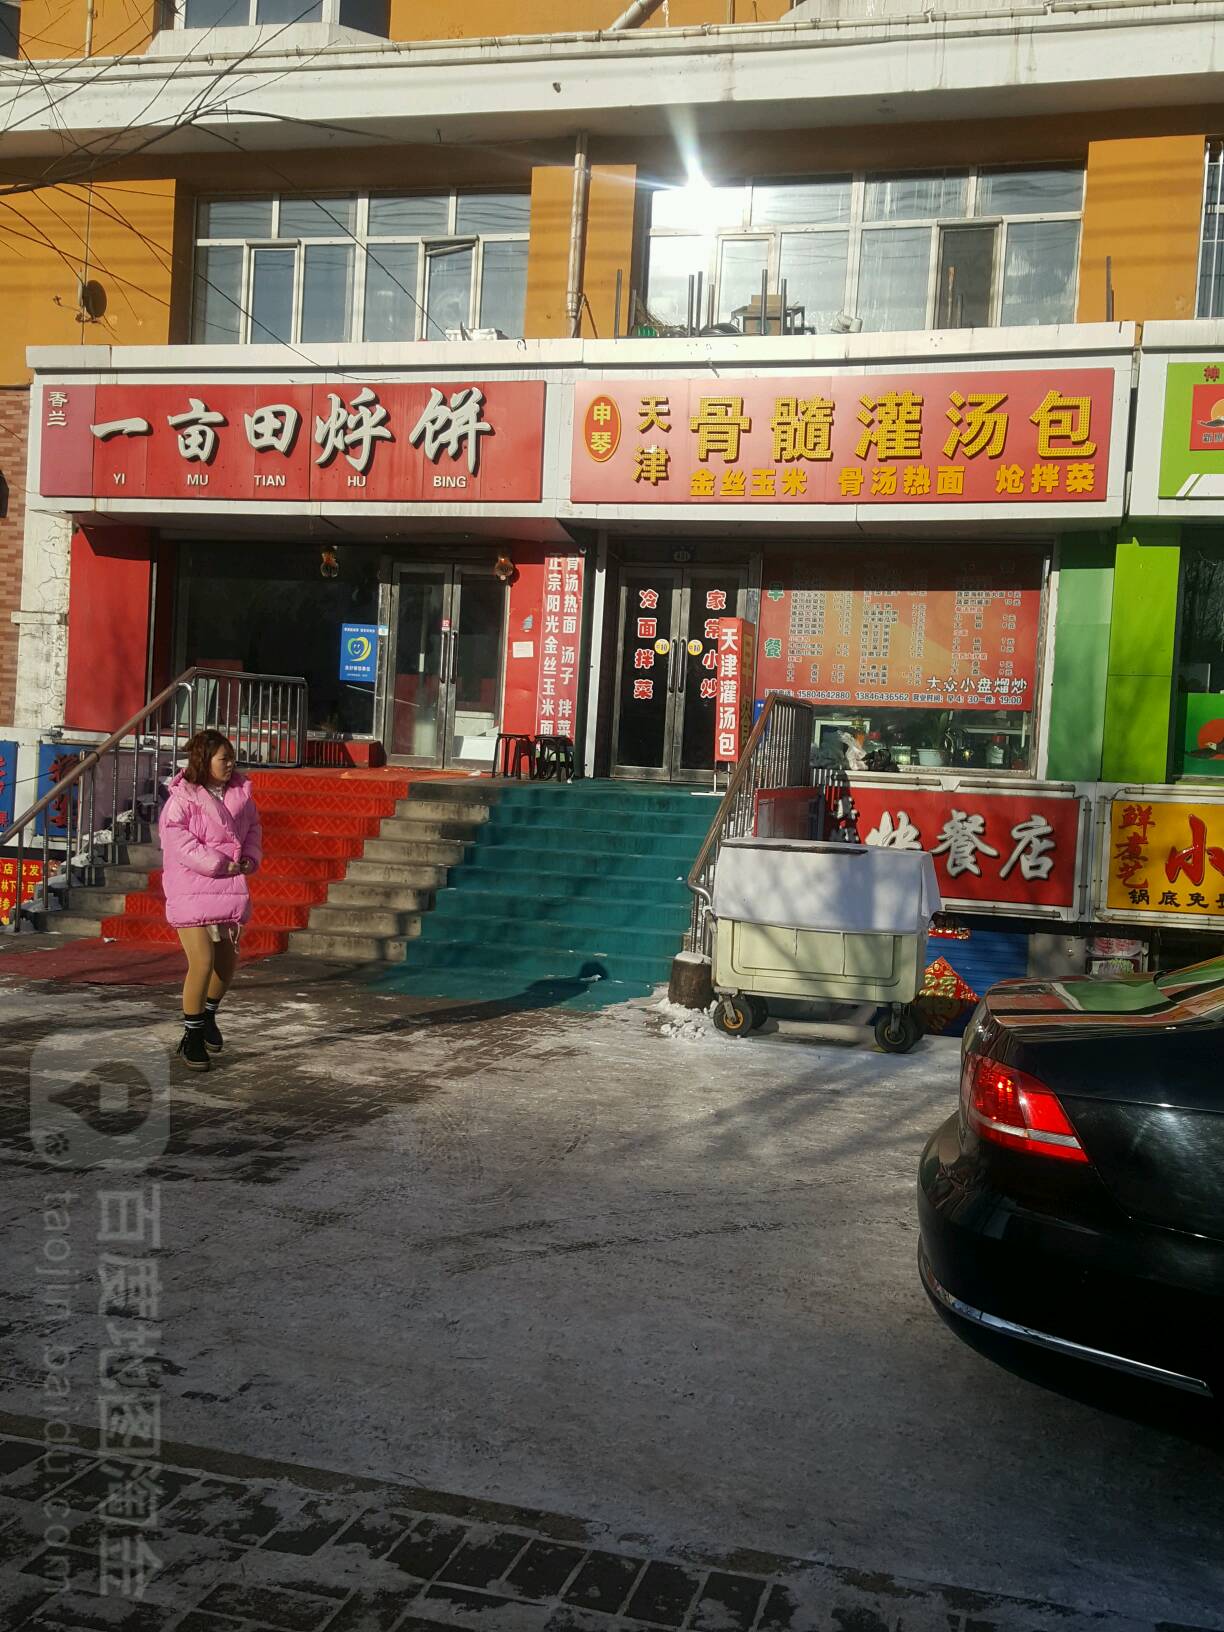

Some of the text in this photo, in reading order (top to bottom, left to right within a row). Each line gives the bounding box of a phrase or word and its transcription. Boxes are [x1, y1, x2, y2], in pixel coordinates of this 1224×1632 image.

[47, 391, 68, 427] 香兰
[89, 386, 496, 476] 一亩田烀饼
[590, 401, 612, 454] 申琴
[631, 395, 672, 487] 天津
[689, 388, 1099, 464] 骨髓灌汤包
[113, 473, 468, 489] YI MU TIAN HU BING
[689, 466, 808, 498] 金丝玉米
[837, 464, 966, 497] 骨汤热面
[633, 588, 659, 700] 冷面拌菜
[717, 627, 739, 756] 天津灌汤包
